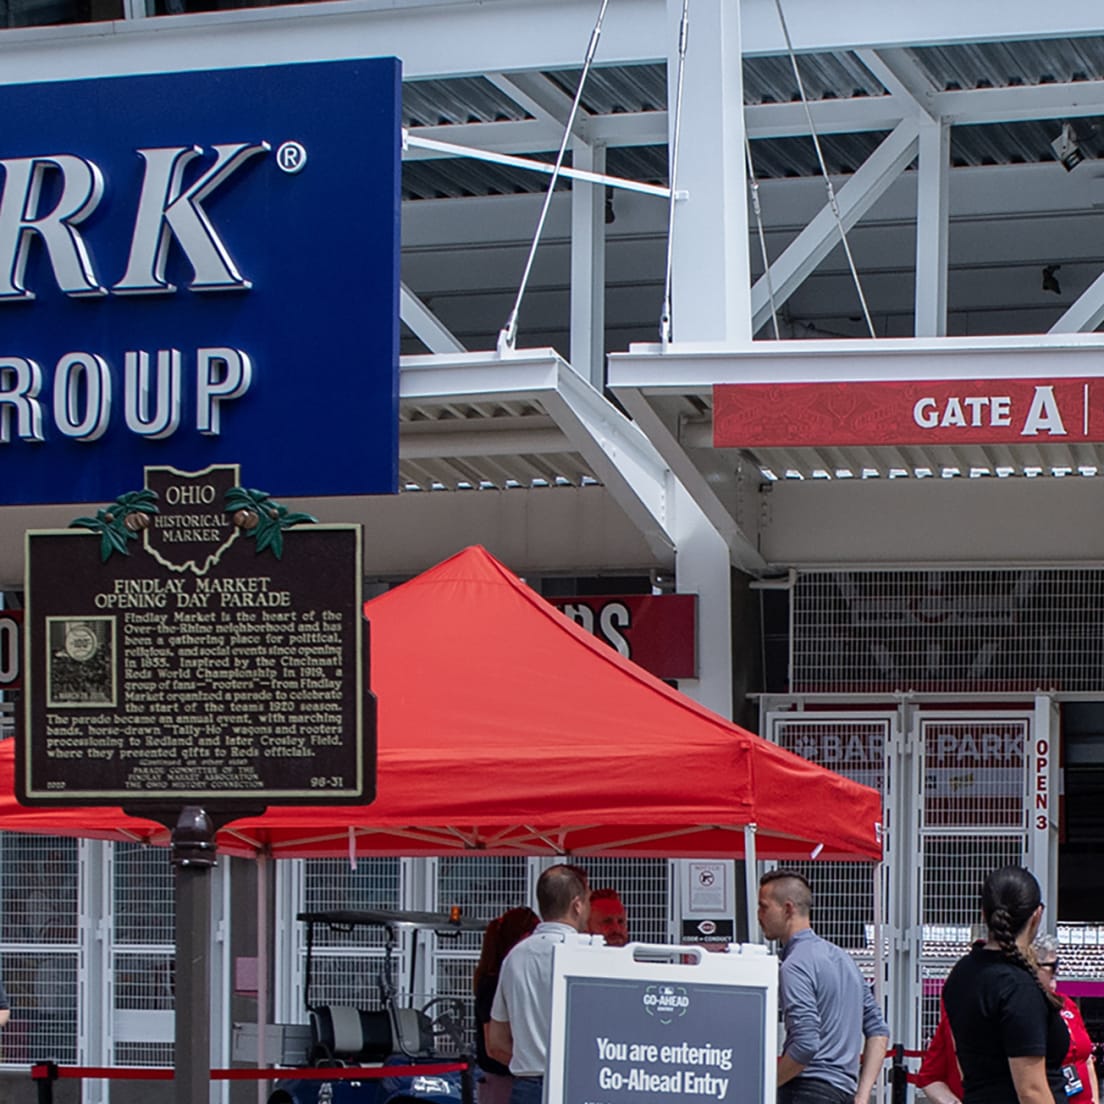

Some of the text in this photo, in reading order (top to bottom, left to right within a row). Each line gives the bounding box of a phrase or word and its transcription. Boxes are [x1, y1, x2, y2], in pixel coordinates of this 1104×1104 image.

[913, 386, 1068, 436] GATE A
[166, 485, 216, 505] OHIO
[154, 513, 230, 528] HISTORICAL
[161, 528, 221, 543] MARKER
[114, 577, 271, 594] FINDLAY MARKET
[94, 592, 291, 609] OPENING DAY PARADE
[125, 611, 342, 623] Findlay Market is the heart of the
[216, 623, 295, 634] neighborhood
[298, 623, 319, 632] and
[322, 623, 342, 631] has
[125, 635, 152, 645] been
[169, 635, 224, 646] gathering
[230, 634, 260, 646] place
[266, 634, 283, 644] for
[178, 647, 198, 656] and
[299, 646, 342, 656] opening
[125, 657, 342, 669] in Inspired by the Cincinnati
[125, 669, 151, 679] Reds
[158, 669, 190, 678] World
[196, 669, 277, 680] Championship
[283, 668, 295, 678] in
[124, 679, 342, 691] group of Findlay
[125, 691, 164, 700] Market
[167, 691, 222, 702] organized
[234, 691, 272, 702] parade
[276, 691, 287, 699] to
[289, 691, 342, 699] celebrate
[125, 703, 144, 712] the
[150, 703, 178, 712] start
[185, 703, 197, 712] of
[205, 703, 226, 712] the
[270, 702, 294, 711] 1920
[46, 714, 69, 724] The
[72, 714, 111, 726] parade
[114, 714, 156, 724] became
[176, 714, 213, 723] annual
[259, 713, 285, 723] with
[288, 713, 342, 725] marching
[88, 725, 342, 736] horse-drawn wagons and rooters
[47, 736, 305, 748] processioning to Redland and later Crosley
[938, 733, 1024, 761] PARK
[47, 748, 83, 758] where
[88, 748, 114, 759] they
[120, 748, 176, 759] presented
[181, 748, 210, 759] gifts
[215, 747, 226, 757] to
[231, 747, 259, 757] Reds
[1036, 740, 1048, 830] OPEN 3
[643, 994, 689, 1007] GO-AHEAD
[596, 1038, 733, 1071] You are entering
[600, 1067, 728, 1099] Go-Ahead Entry
